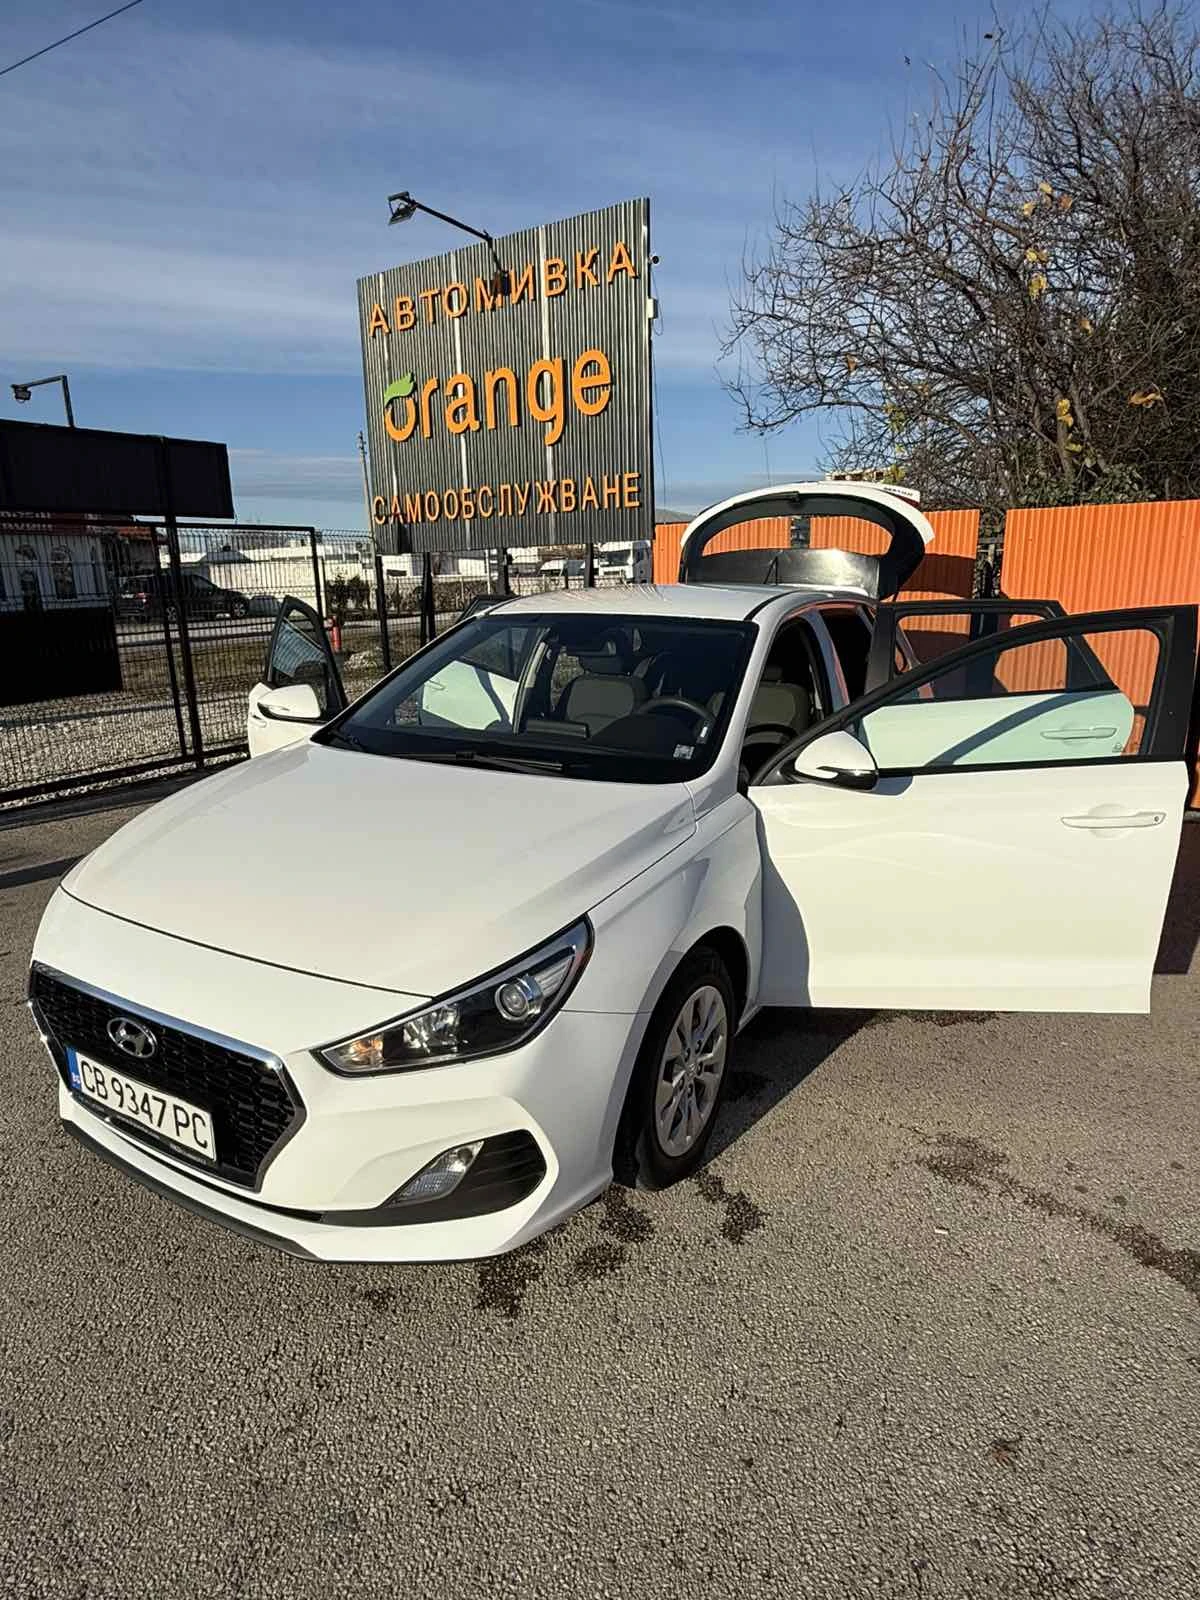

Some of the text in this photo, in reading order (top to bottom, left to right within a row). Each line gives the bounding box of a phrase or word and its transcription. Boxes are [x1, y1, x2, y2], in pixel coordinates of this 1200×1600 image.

[368, 241, 638, 337] АВТОМИВКА
[384, 348, 612, 446] orange
[373, 473, 640, 525] САМООБСЛУЖВАНЕ
[81, 1060, 108, 1099] CB
[110, 1077, 167, 1128] 9347
[173, 1104, 208, 1149] PC
